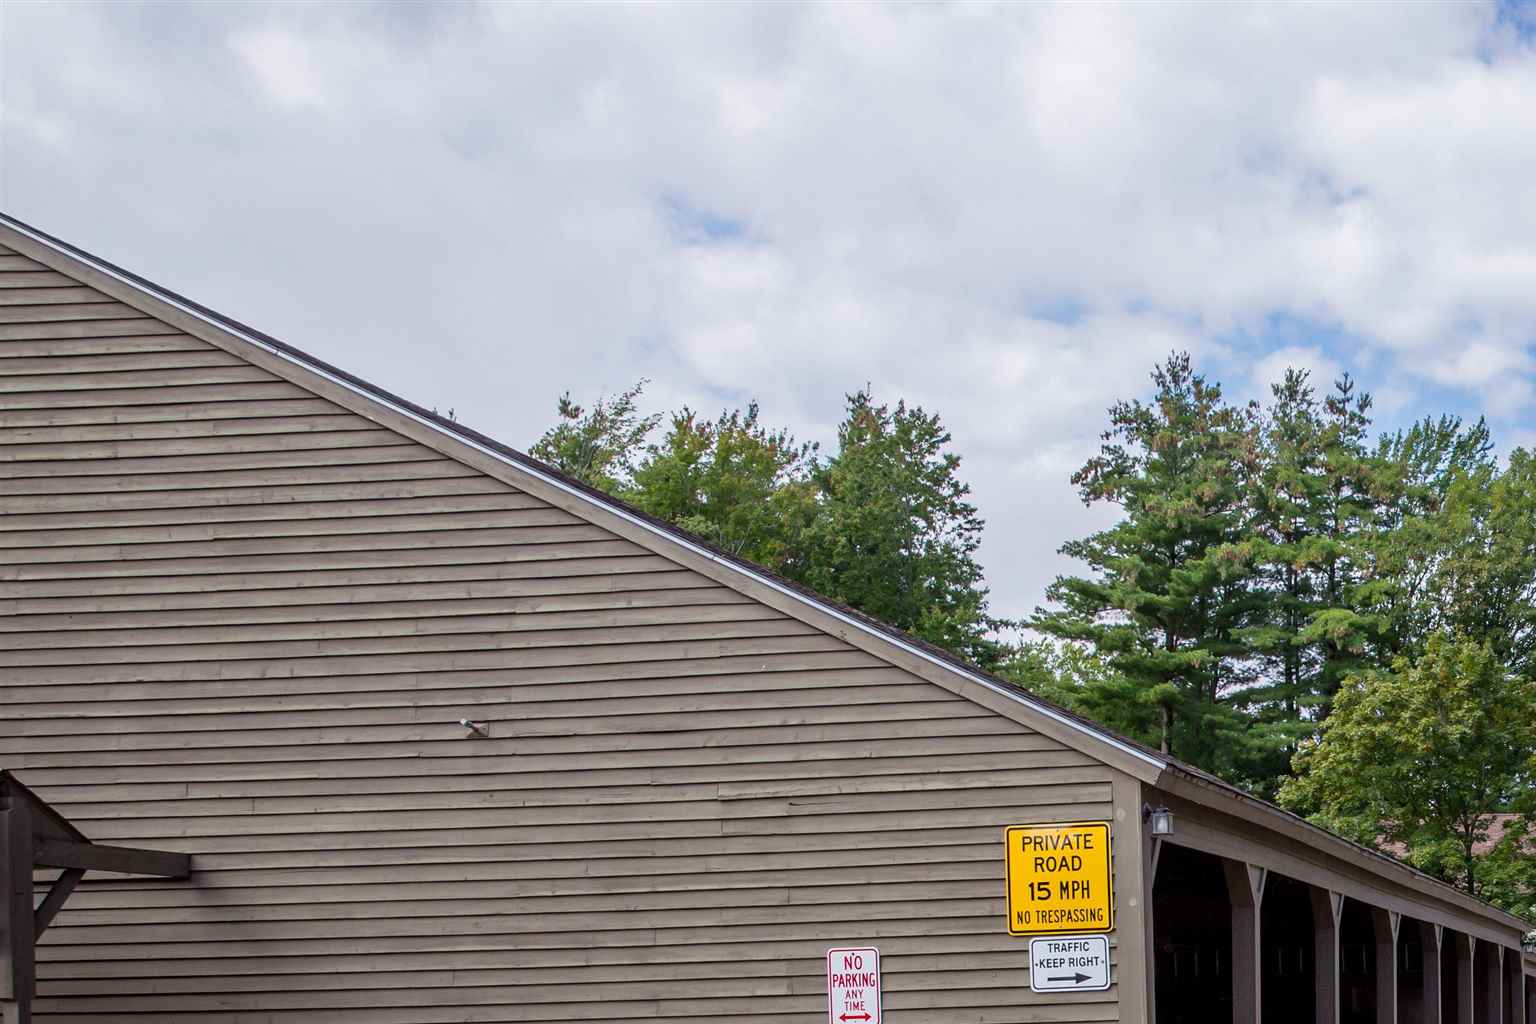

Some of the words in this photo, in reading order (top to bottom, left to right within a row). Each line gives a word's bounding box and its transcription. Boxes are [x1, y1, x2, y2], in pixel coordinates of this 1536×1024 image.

[1022, 833, 1094, 852] PRIVATE
[1034, 855, 1083, 873] ROAD
[1028, 881, 1052, 901] 15
[1059, 880, 1090, 900] MPH
[1017, 910, 1031, 925] NO
[1035, 907, 1104, 924] TRESPASSING
[1047, 941, 1090, 953] TRAFFIC
[844, 955, 863, 970] NO
[1039, 957, 1066, 969] KEEP
[1068, 956, 1100, 967] RIGHT
[832, 972, 876, 988] PARKING
[845, 989, 864, 1000] ANY
[844, 1000, 866, 1011] TIME
